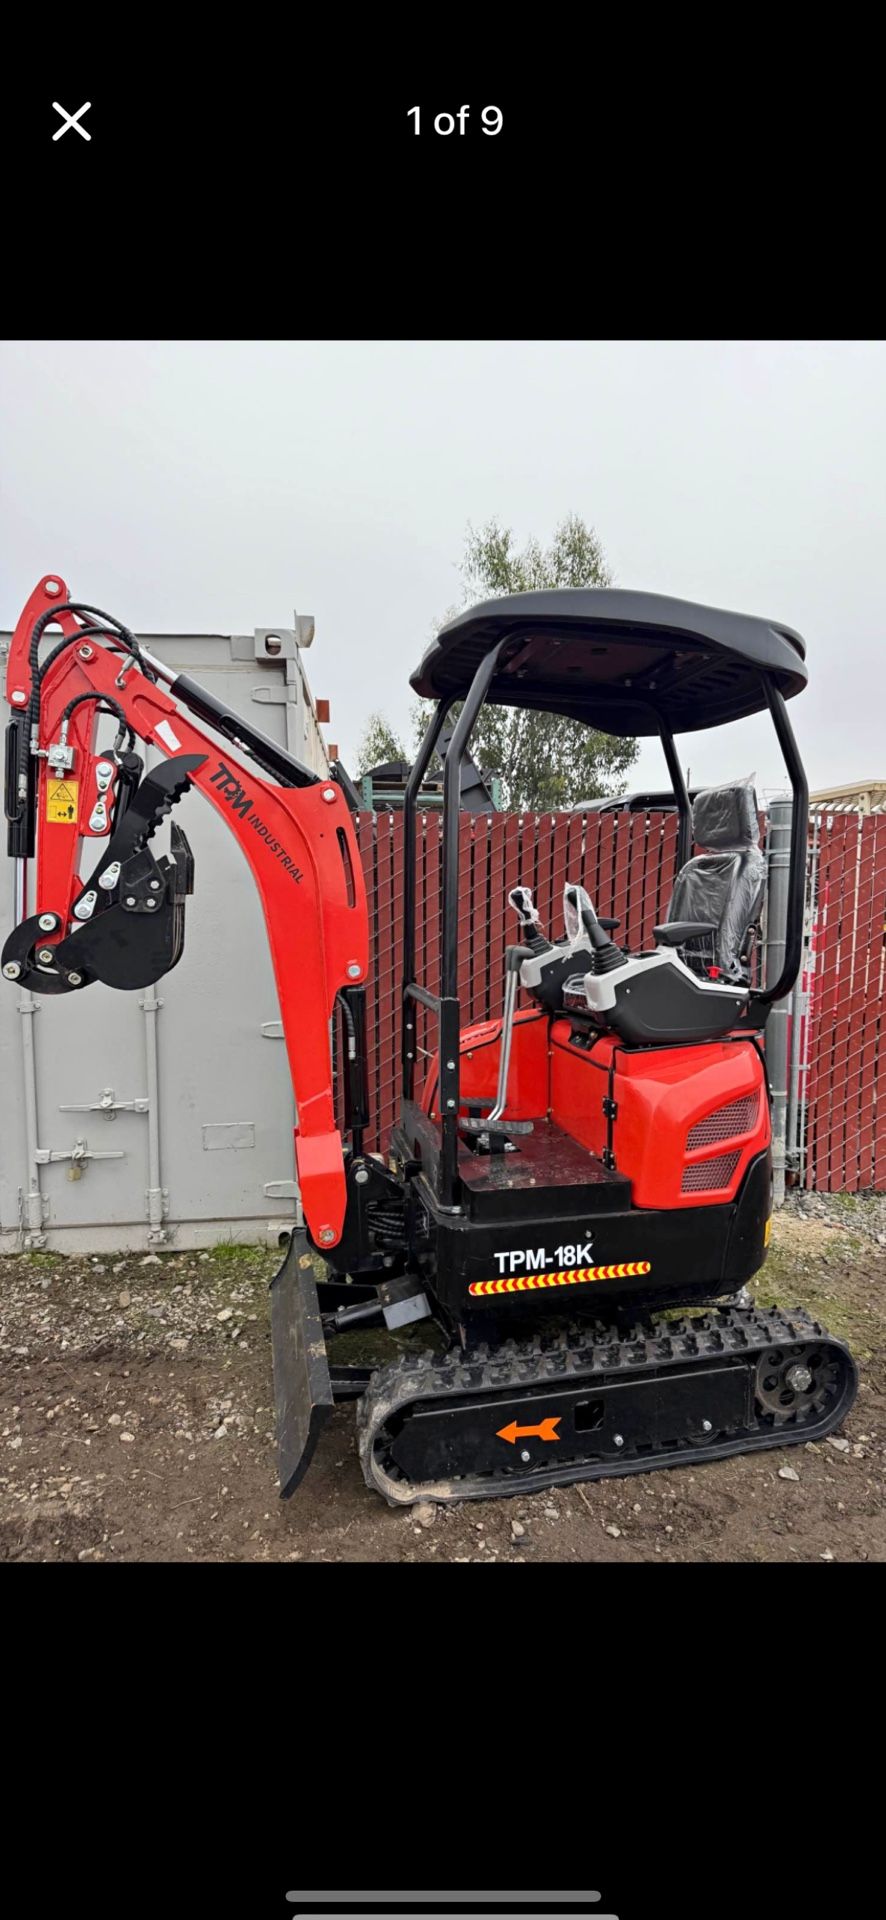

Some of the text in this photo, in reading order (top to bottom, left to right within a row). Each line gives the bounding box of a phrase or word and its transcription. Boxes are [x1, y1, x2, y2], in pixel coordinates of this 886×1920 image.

[209, 762, 304, 885] TPM INDUSTRIAL
[494, 1243, 594, 1273] TPM-18K
